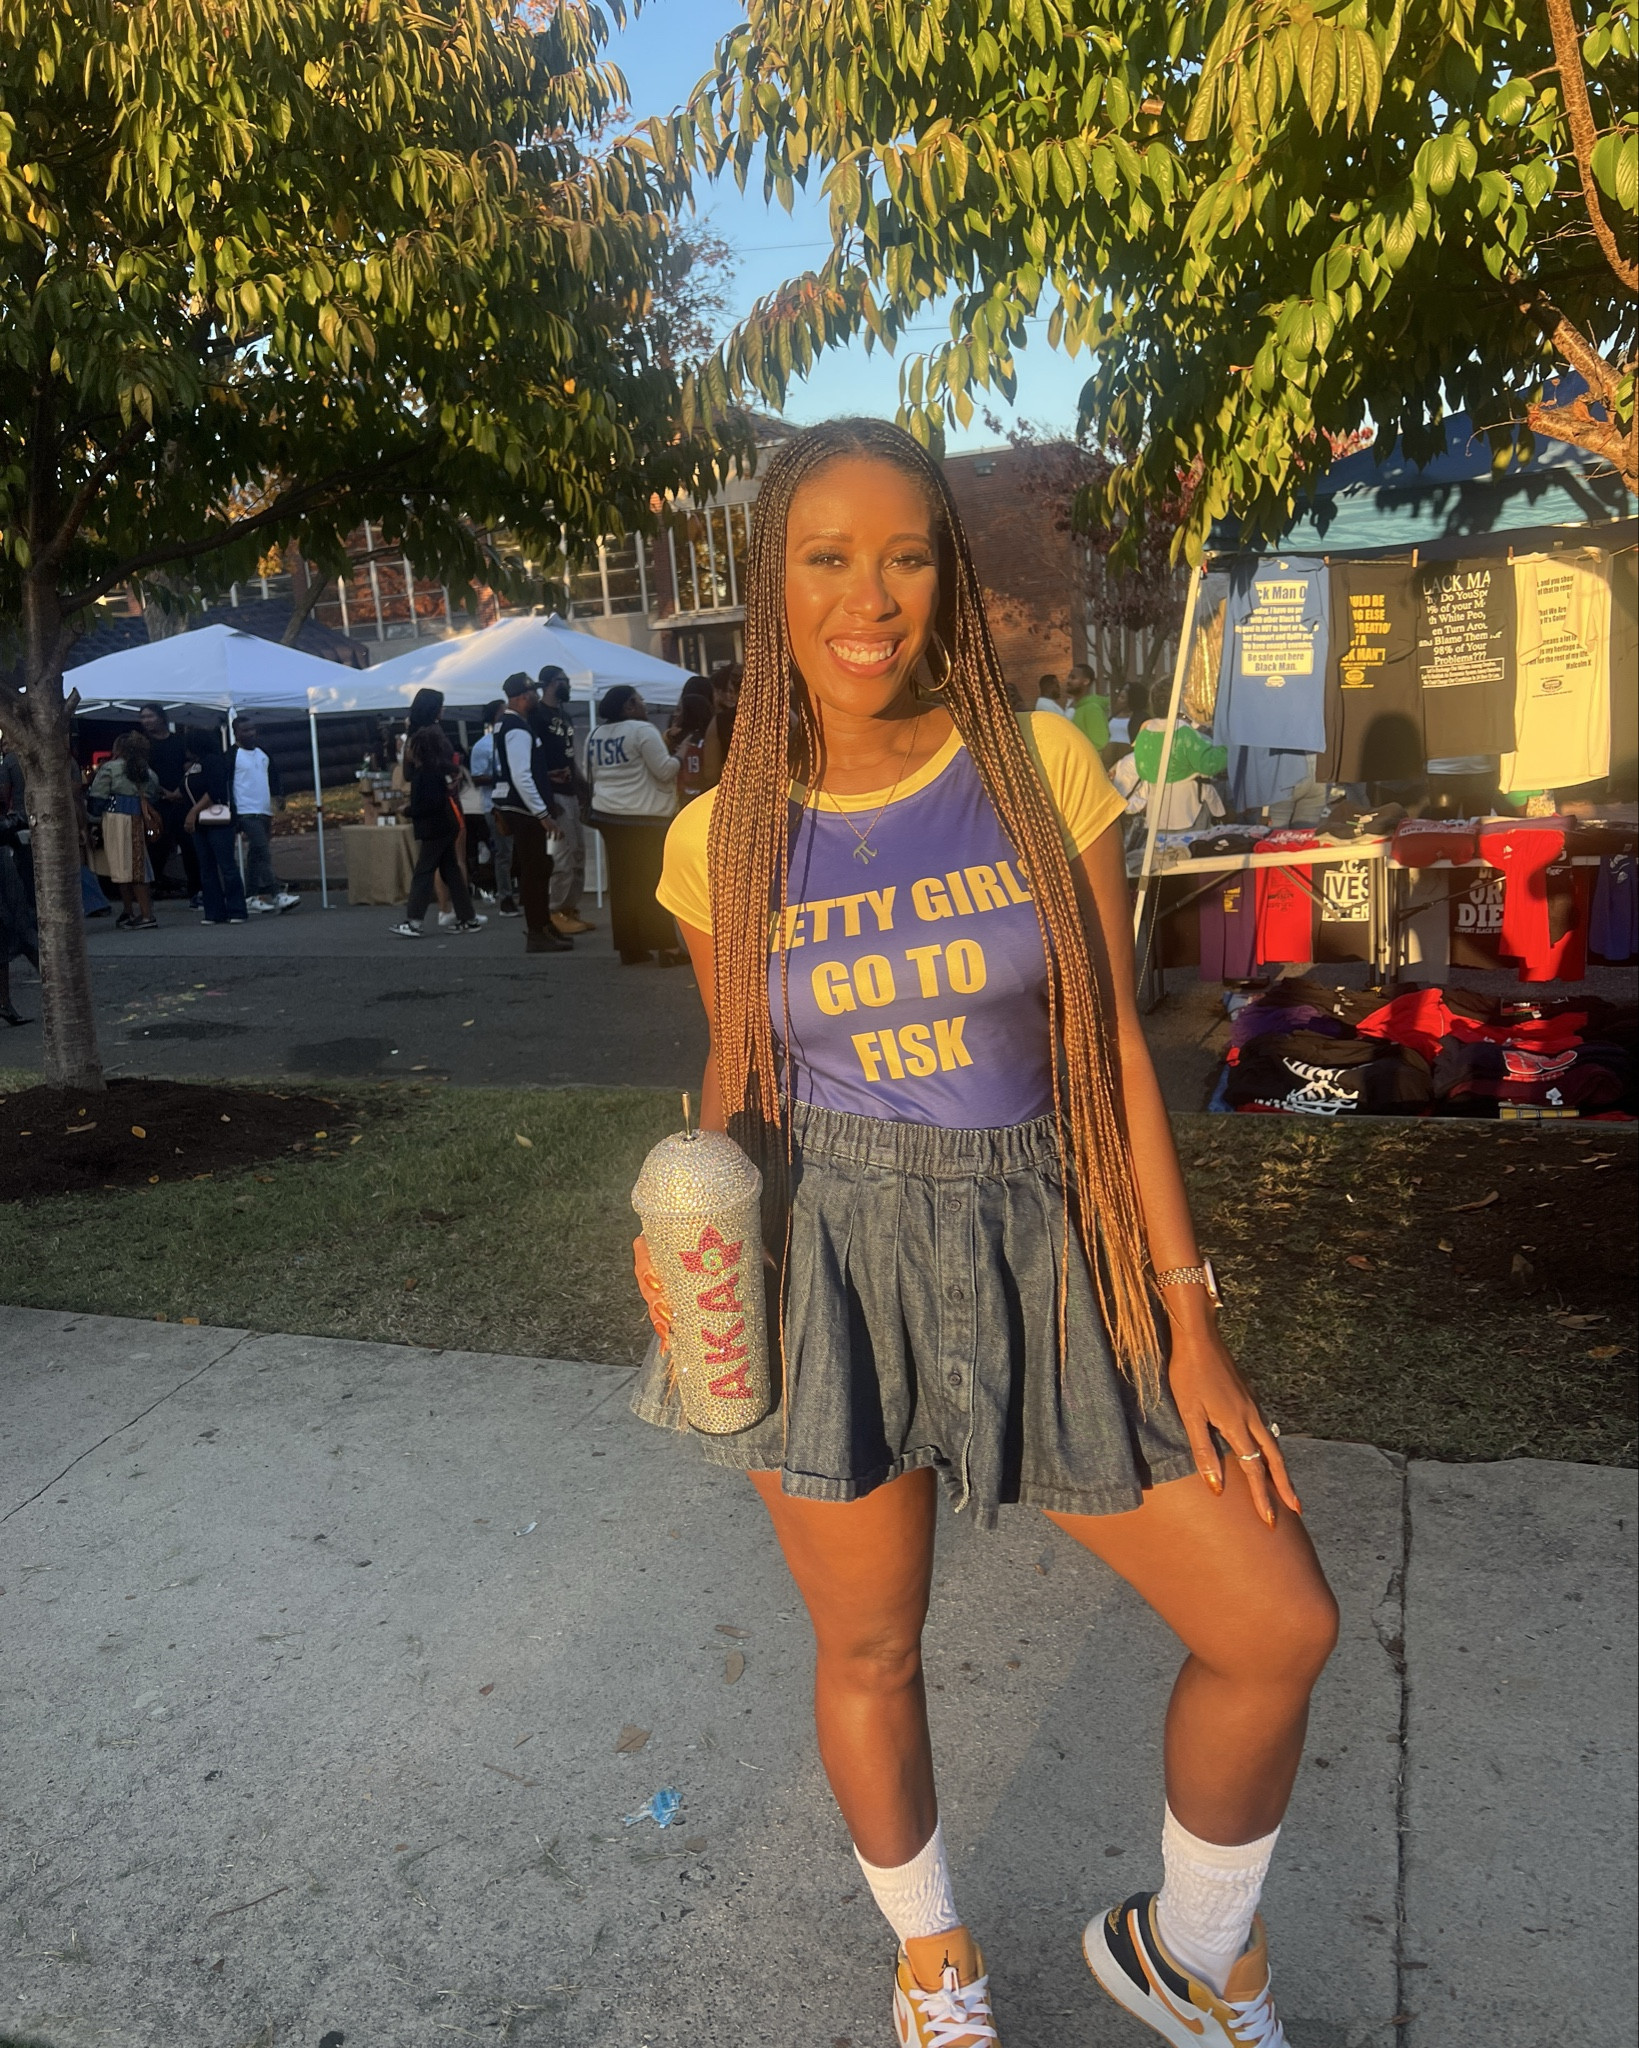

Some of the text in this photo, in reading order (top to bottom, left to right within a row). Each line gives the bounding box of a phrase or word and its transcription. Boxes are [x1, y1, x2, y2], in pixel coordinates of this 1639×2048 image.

[1272, 586, 1296, 600] Man
[1441, 594, 1454, 603] Do
[1440, 603, 1451, 613] of
[1451, 602, 1473, 613] your
[1365, 609, 1385, 620] ELSE
[1438, 613, 1465, 623] White
[1444, 625, 1465, 634] Turn
[1434, 635, 1462, 646] Blame
[1463, 632, 1488, 641] Them
[1433, 643, 1487, 655] 98% of Your
[1248, 652, 1304, 661] Be safe out here
[1434, 651, 1487, 665] Problems???
[1255, 662, 1277, 671] Black
[1566, 661, 1587, 670] Malcolm
[588, 736, 629, 767] FISK
[1469, 880, 1503, 904] OR
[1458, 904, 1504, 927] DIE
[811, 939, 987, 1016] GO TO
[851, 1016, 974, 1082] FISK
[697, 1272, 753, 1399] AKA
